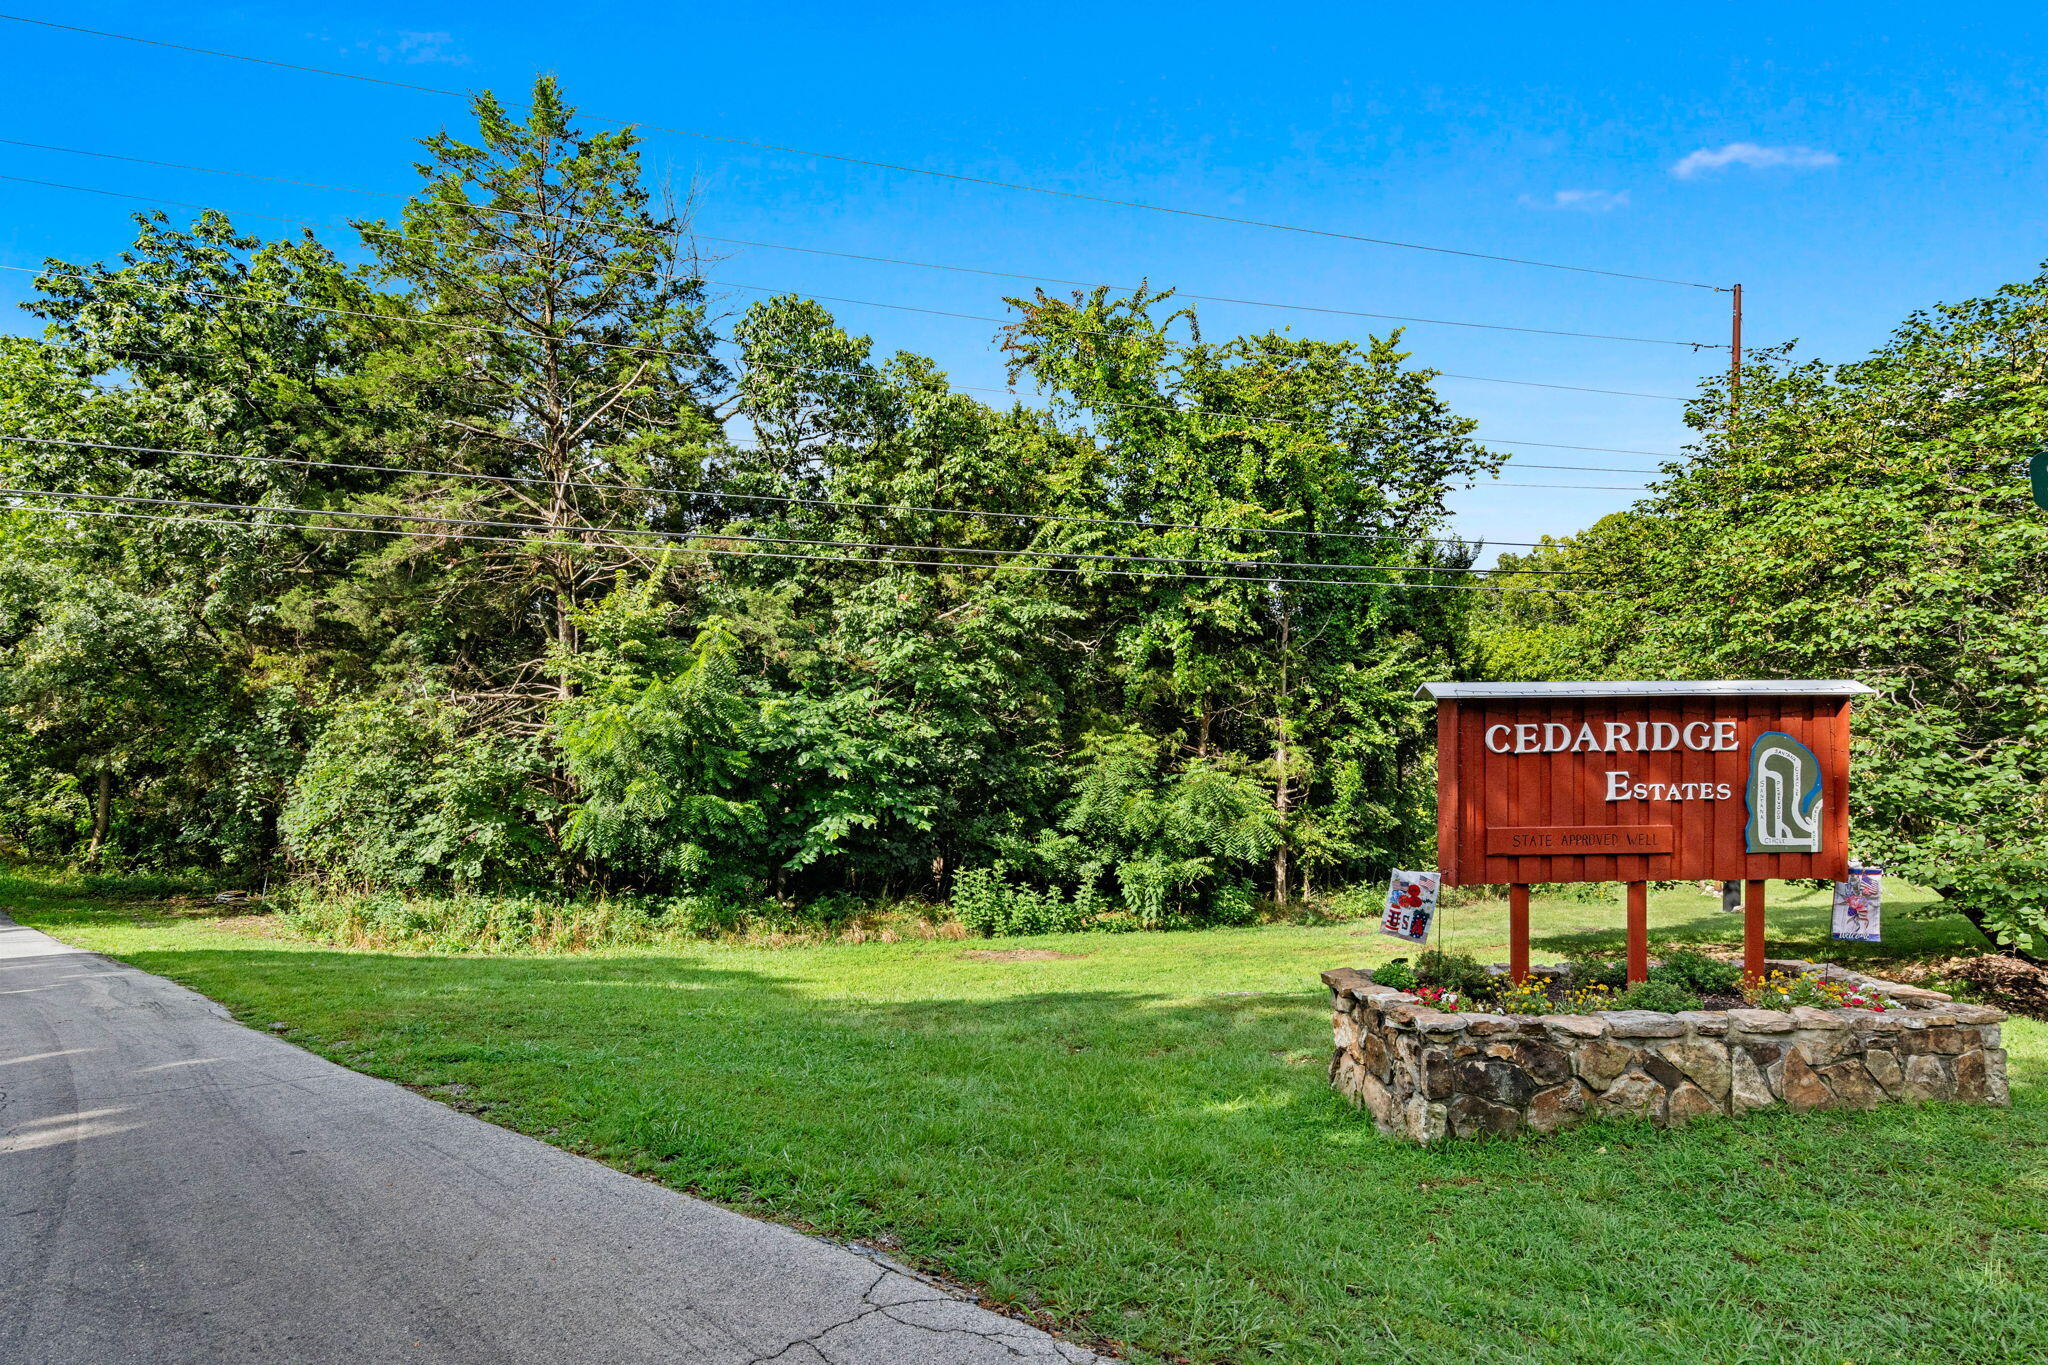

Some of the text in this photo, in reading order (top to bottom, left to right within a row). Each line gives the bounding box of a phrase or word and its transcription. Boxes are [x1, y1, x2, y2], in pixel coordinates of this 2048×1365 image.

[1485, 721, 1740, 754] CEDARIDGE
[1512, 832, 1658, 848] STATE APPROVED WELL
